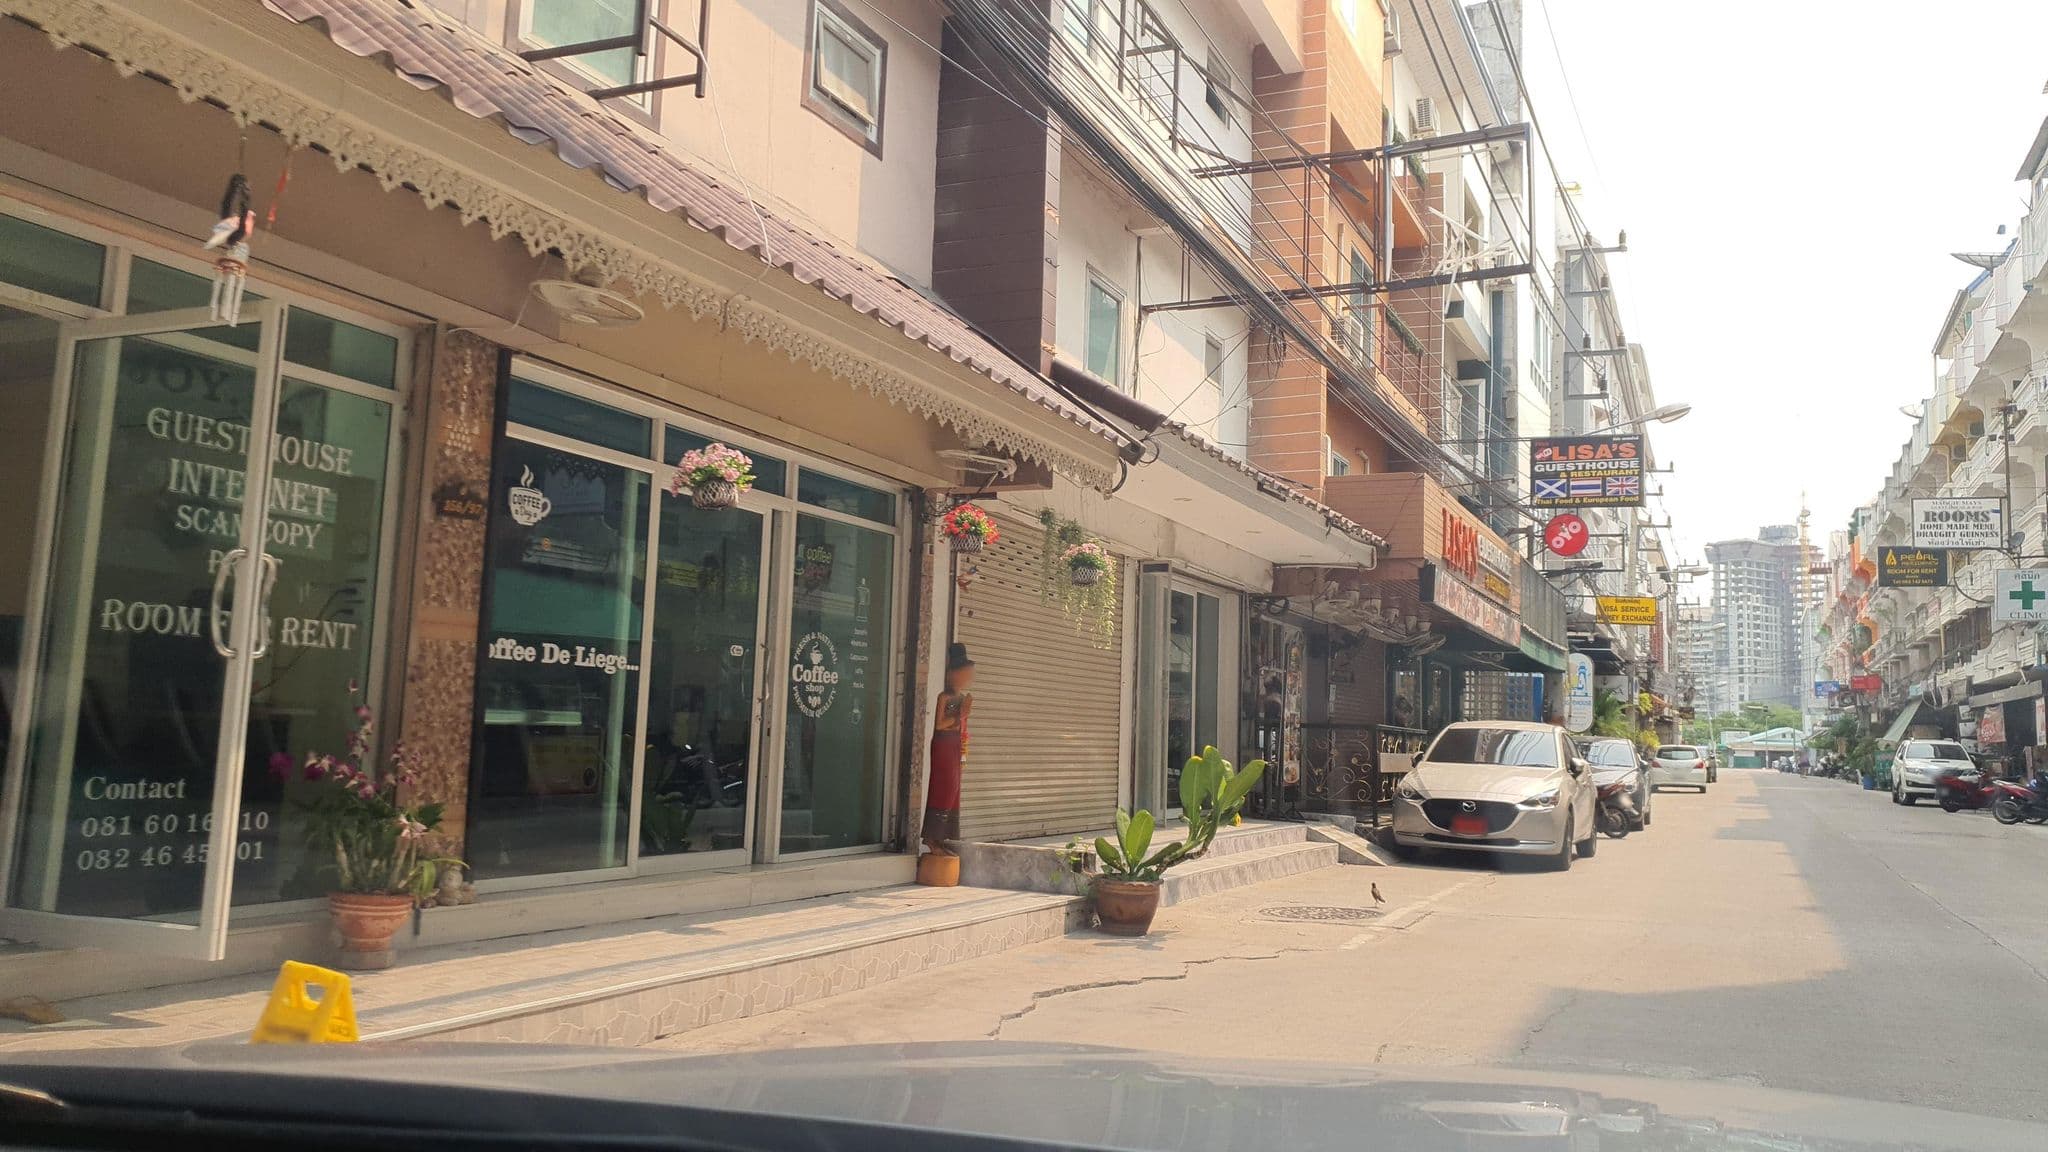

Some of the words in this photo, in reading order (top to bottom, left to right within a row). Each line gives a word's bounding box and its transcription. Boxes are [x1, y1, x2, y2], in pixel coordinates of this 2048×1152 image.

[1552, 442, 1637, 460] LISA'S
[1534, 460, 1640, 473] GUESTHOUSE
[1570, 469, 1640, 478] RESTAURANT
[168, 458, 332, 518] INTENET
[513, 493, 541, 509] COFFEE
[1583, 496, 1619, 504] European
[1620, 494, 1639, 502] Food
[1923, 510, 1991, 523] ROOMS
[1919, 523, 1944, 531] HOME
[1946, 523, 1970, 531] MADE
[1973, 523, 1995, 531] MENU
[1959, 530, 1999, 538] GUINNESS
[2009, 611, 2047, 620] CLINIC
[101, 599, 200, 637] ROOM
[281, 617, 357, 649] RENT
[541, 642, 571, 665] De
[792, 663, 839, 684] Coffee
[805, 682, 825, 695] shop
[84, 776, 188, 800] Contact
[81, 816, 132, 838] 081
[145, 814, 178, 834] 60
[77, 848, 130, 870] 082
[140, 845, 173, 866] 46
